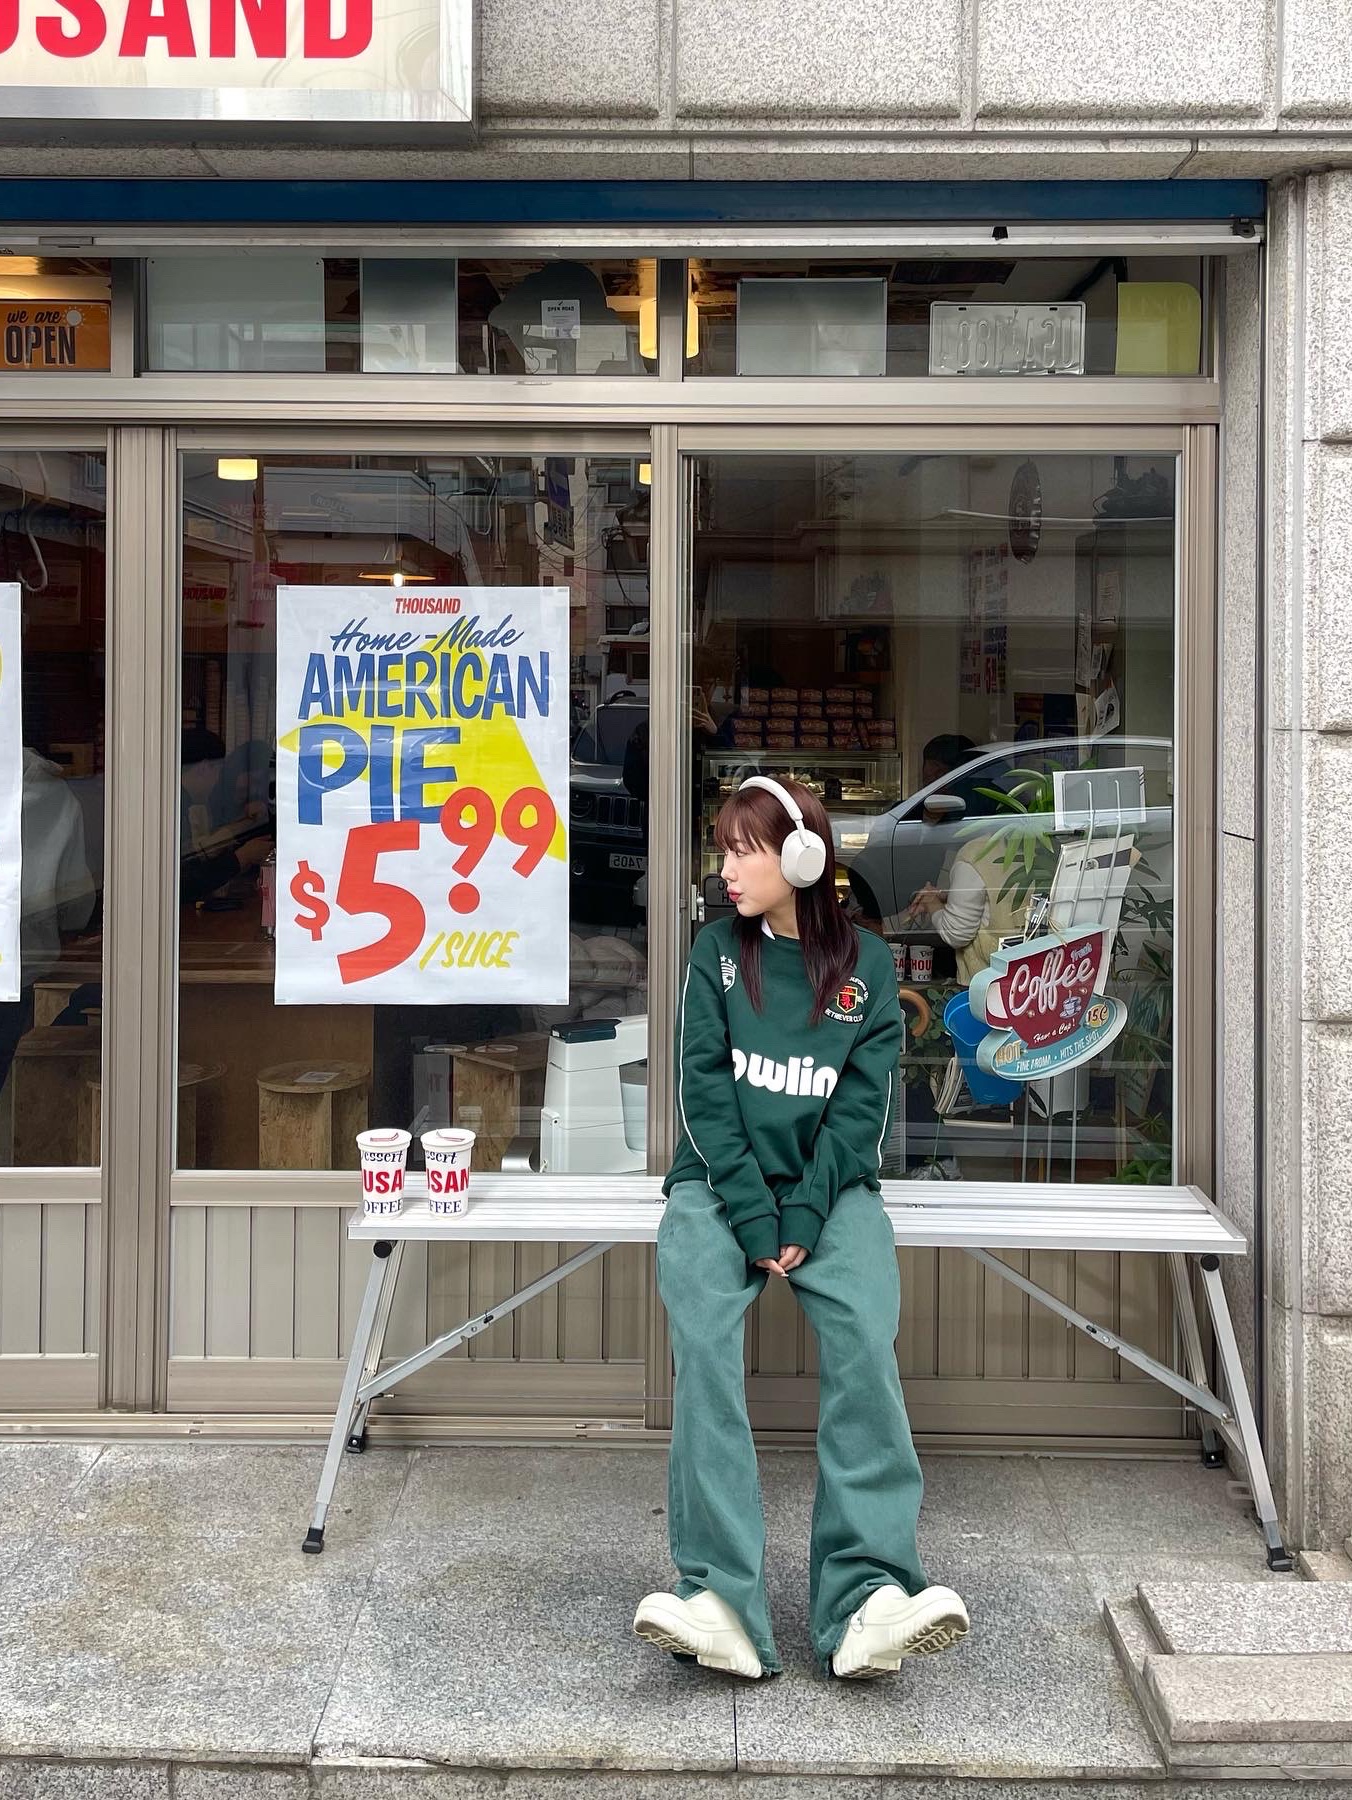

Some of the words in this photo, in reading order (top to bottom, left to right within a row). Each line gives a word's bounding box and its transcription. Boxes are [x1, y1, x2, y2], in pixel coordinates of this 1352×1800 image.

[0, 0, 373, 58] SAND
[7, 310, 28, 323] we
[35, 310, 61, 323] are
[5, 325, 76, 365] OPEN
[395, 598, 461, 614] THOUSAND
[299, 652, 549, 720] AMERICAN
[297, 724, 462, 825] PIE
[1009, 948, 1095, 1016] Coffee
[996, 1040, 1022, 1068] HOT
[1016, 1060, 1030, 1072] FINE
[1060, 1045, 1074, 1059] HITS
[1074, 1038, 1085, 1053] THE
[363, 1150, 403, 1163] essert
